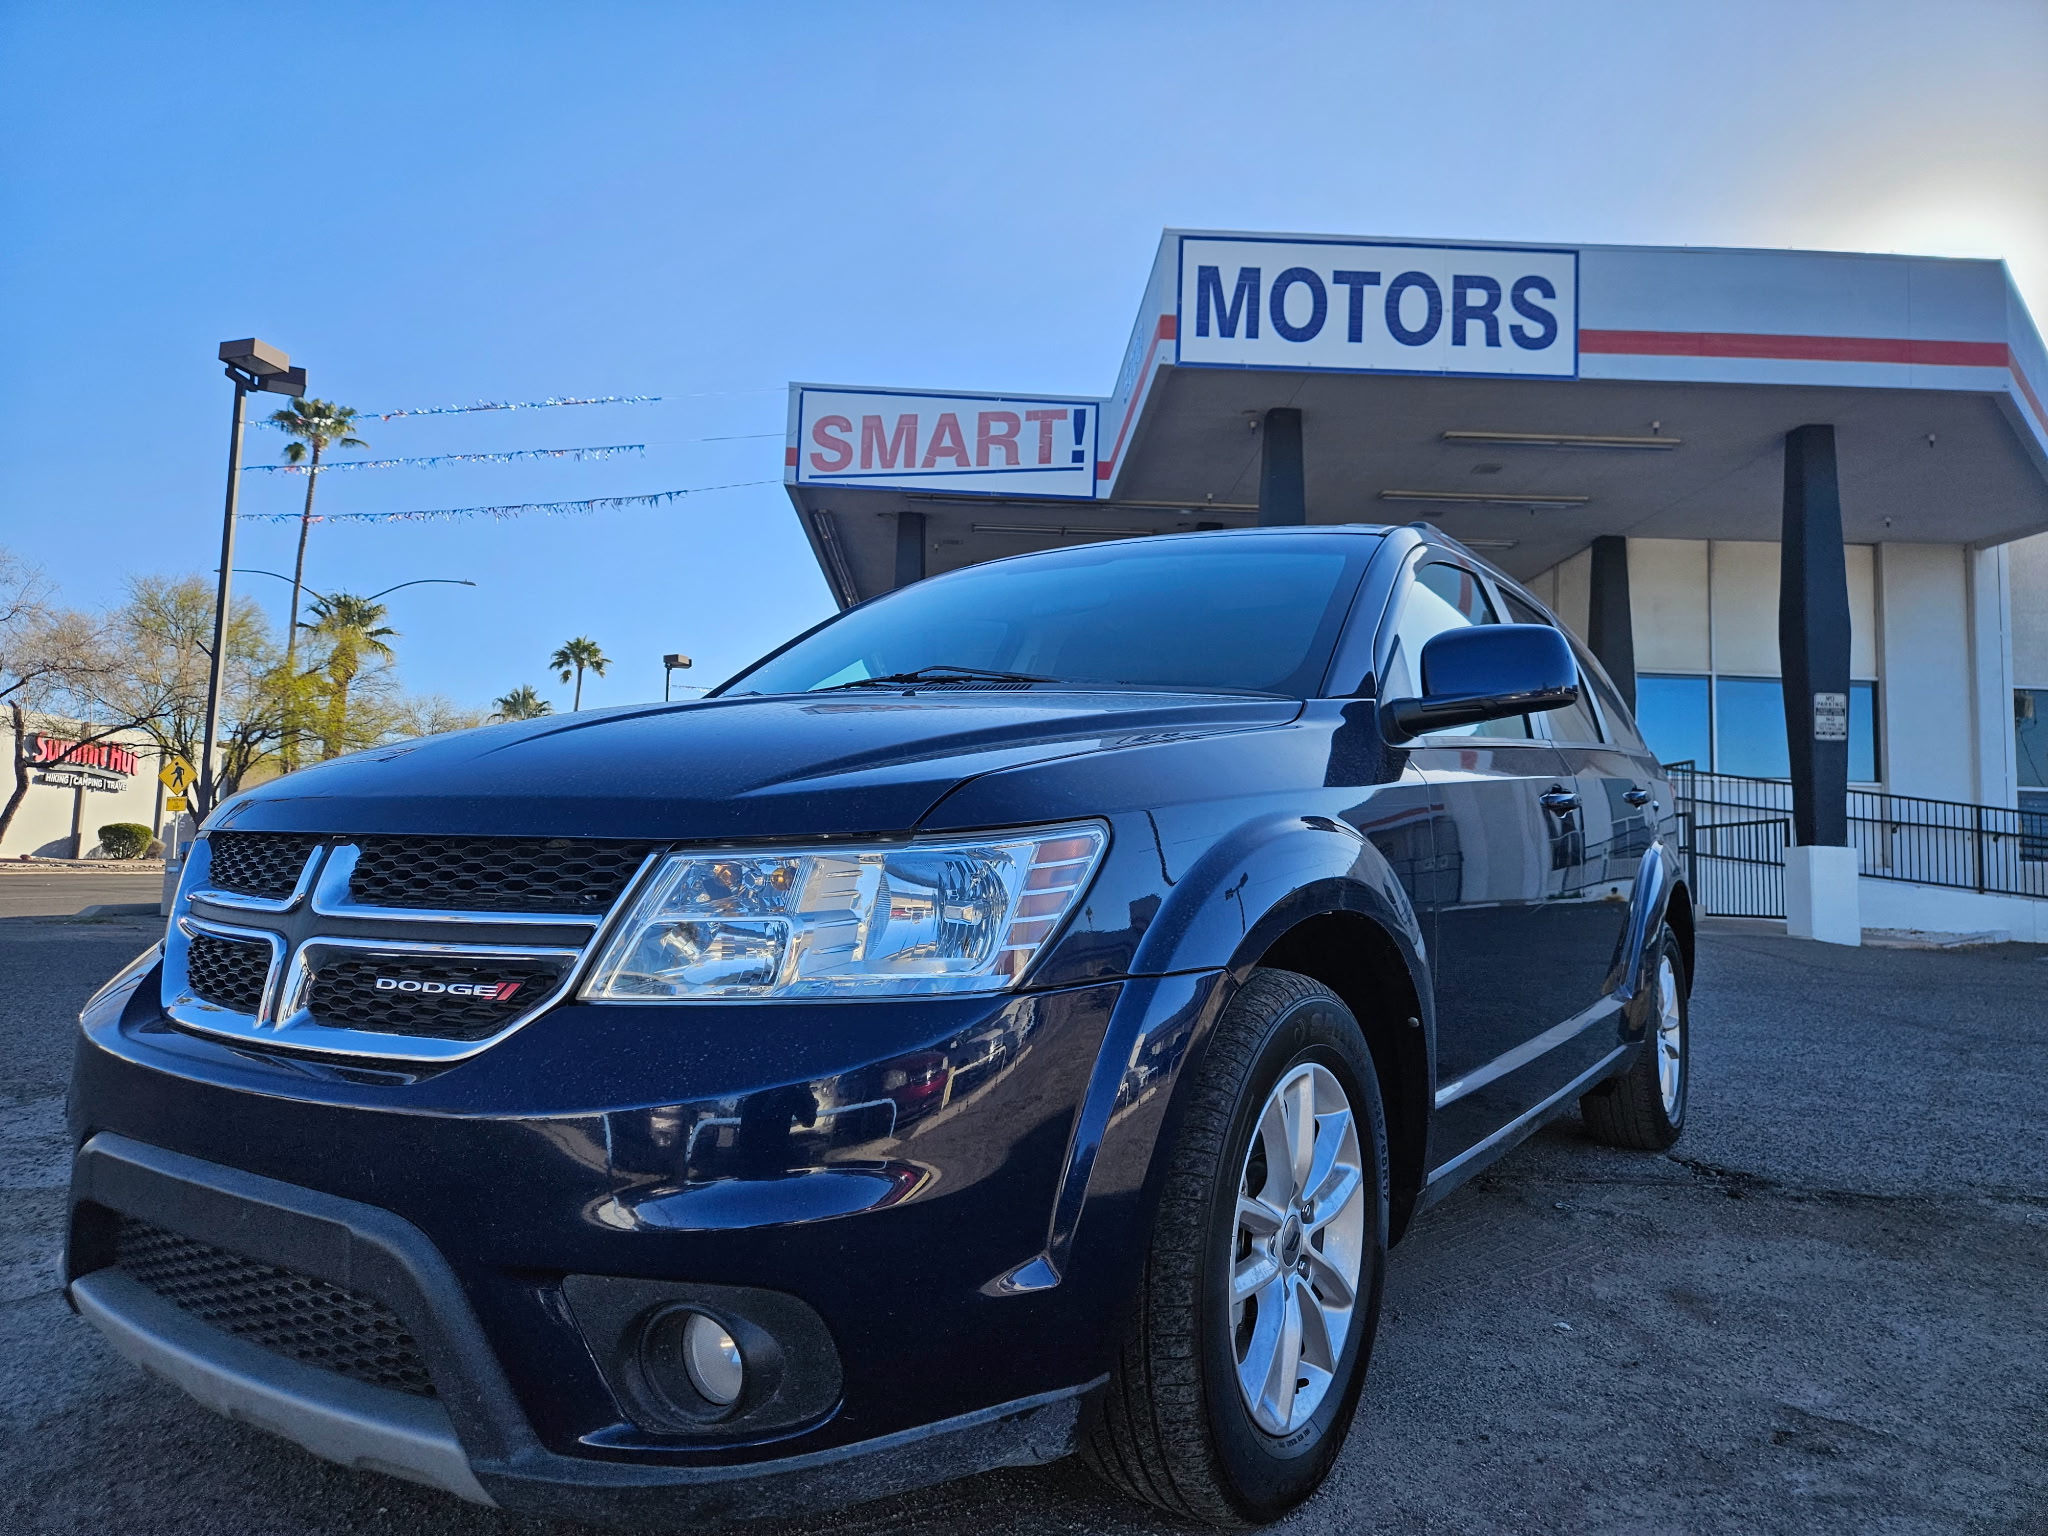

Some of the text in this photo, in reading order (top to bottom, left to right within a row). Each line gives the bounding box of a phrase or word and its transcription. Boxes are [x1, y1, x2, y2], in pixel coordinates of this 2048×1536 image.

[1195, 265, 1558, 350] MOTORS
[809, 407, 1088, 471] SMART!
[34, 731, 139, 776] Summit Hut
[45, 773, 127, 791] HIKING CAMPING TRAVE
[376, 978, 498, 996] DODGE
